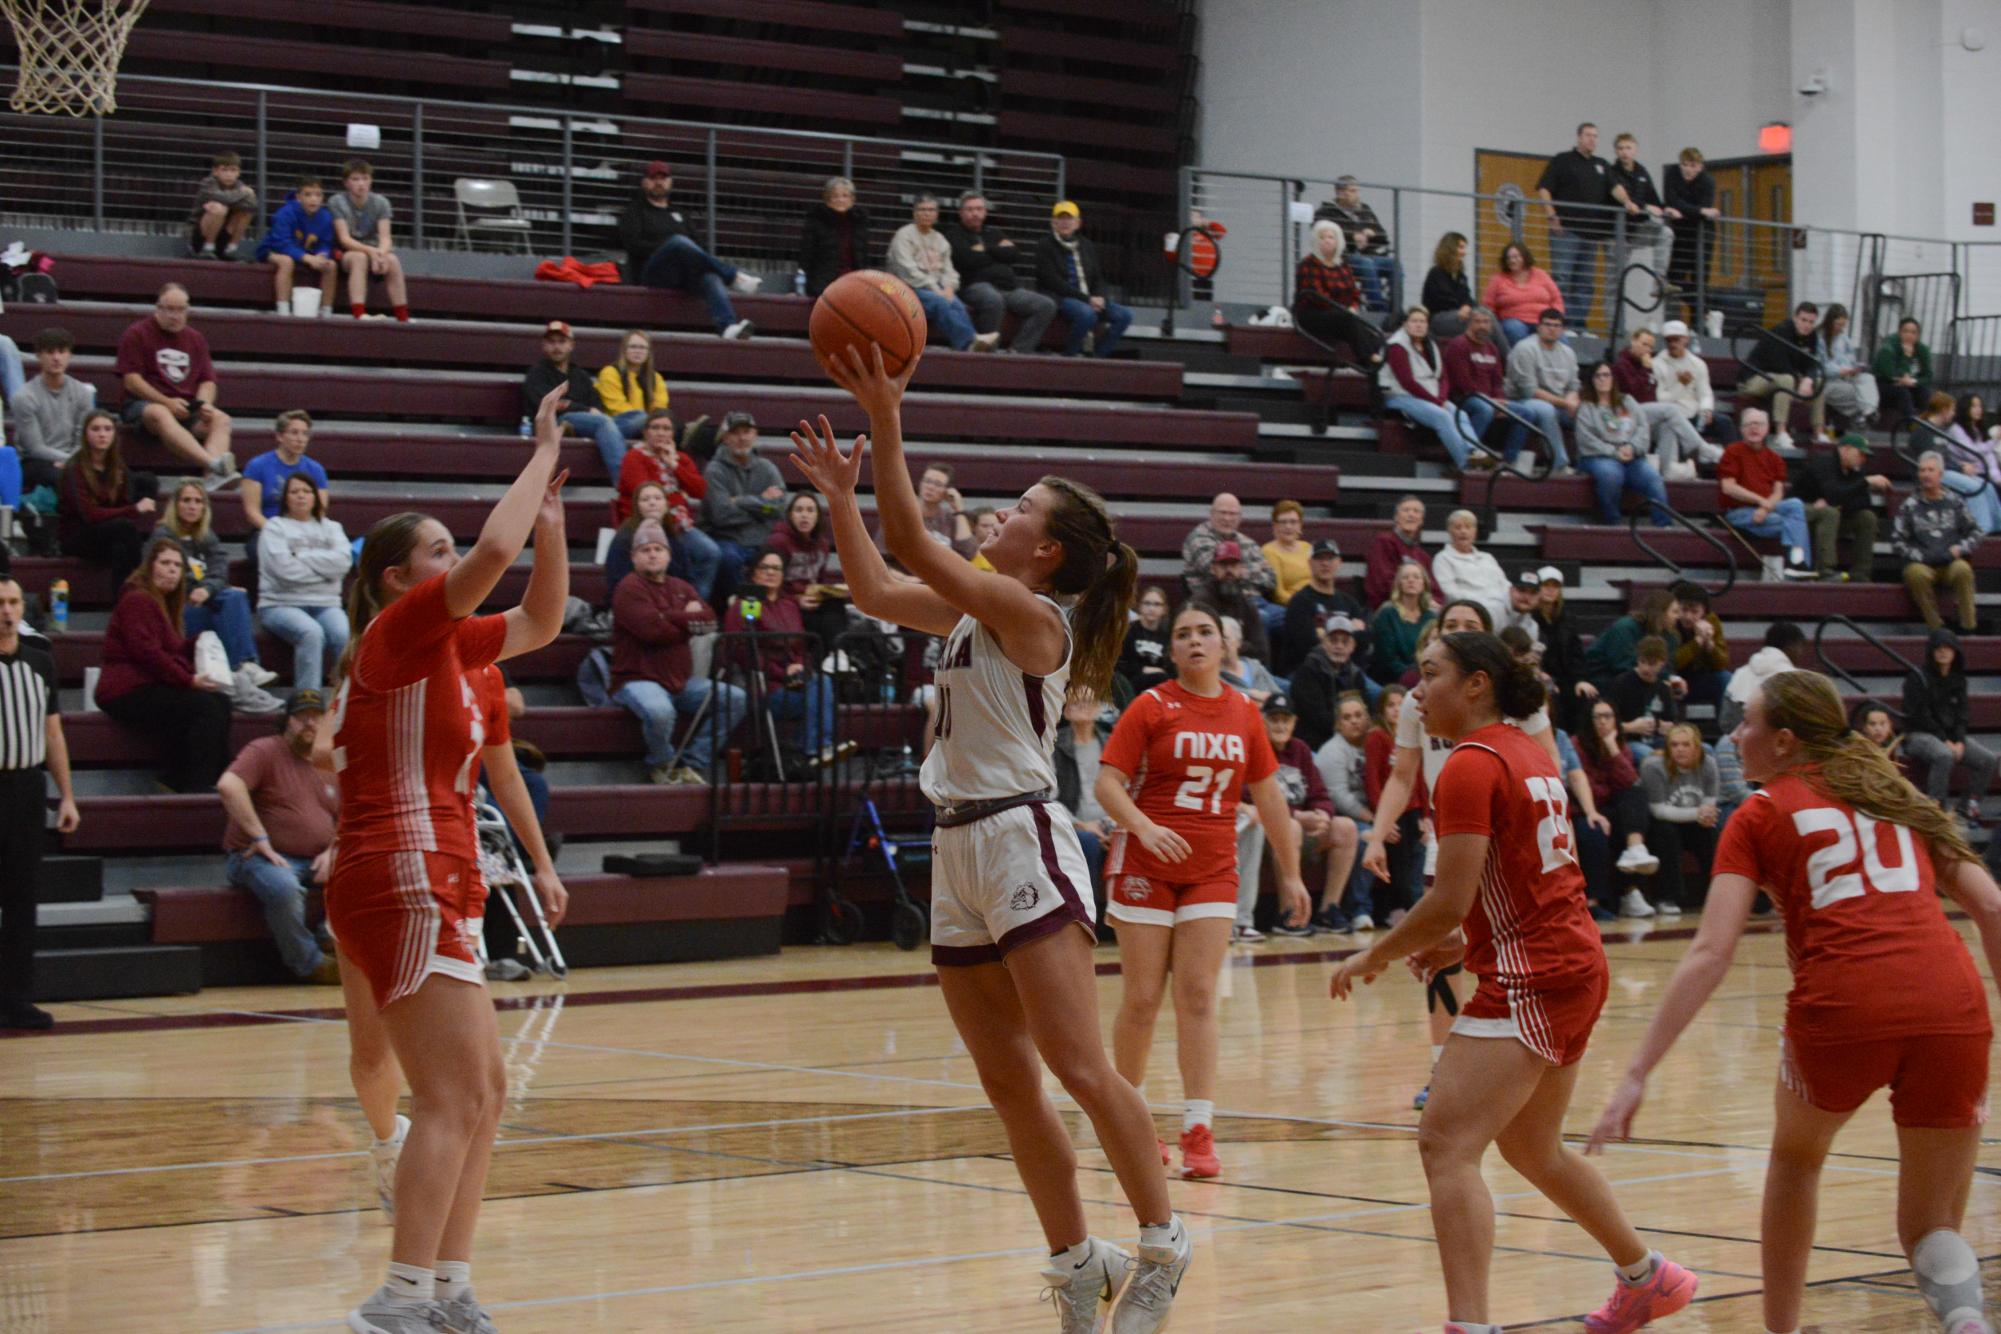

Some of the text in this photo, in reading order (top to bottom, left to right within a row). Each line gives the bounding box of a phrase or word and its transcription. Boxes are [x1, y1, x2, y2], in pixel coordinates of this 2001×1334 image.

[1173, 731, 1246, 763] NIXA
[1173, 765, 1235, 814] 21
[1791, 806, 1920, 910] 20
